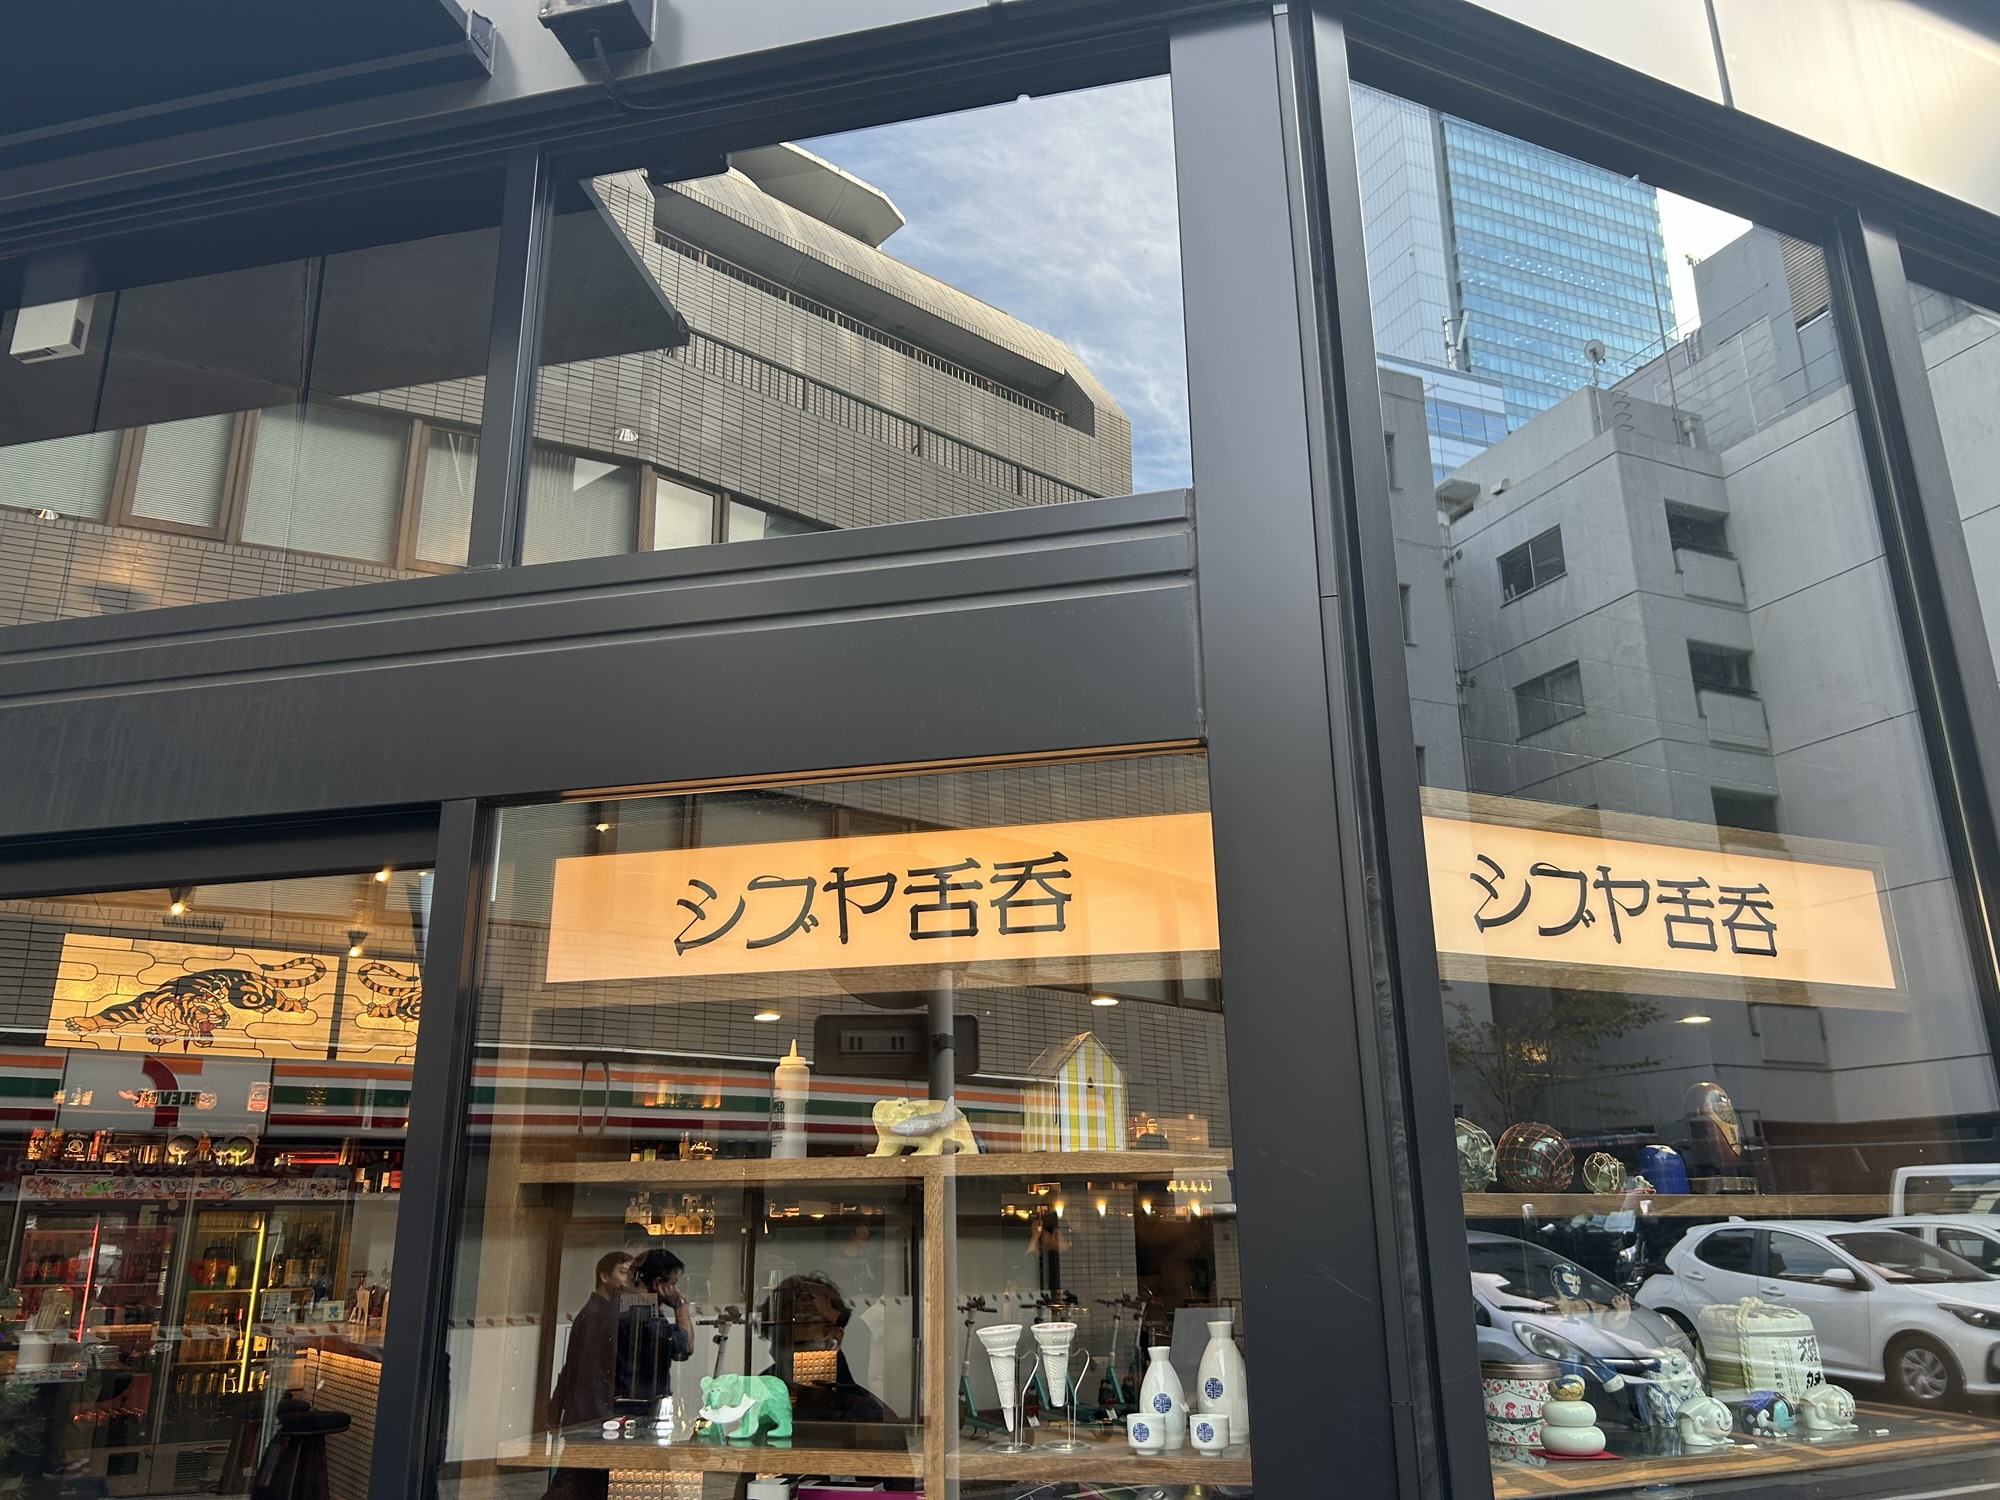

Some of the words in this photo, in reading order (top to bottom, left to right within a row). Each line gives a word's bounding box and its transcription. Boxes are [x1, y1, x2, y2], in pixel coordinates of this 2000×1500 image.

[674, 850, 1073, 957] シブヤ舌呑
[1469, 852, 1779, 958] シブヤ舌呑
